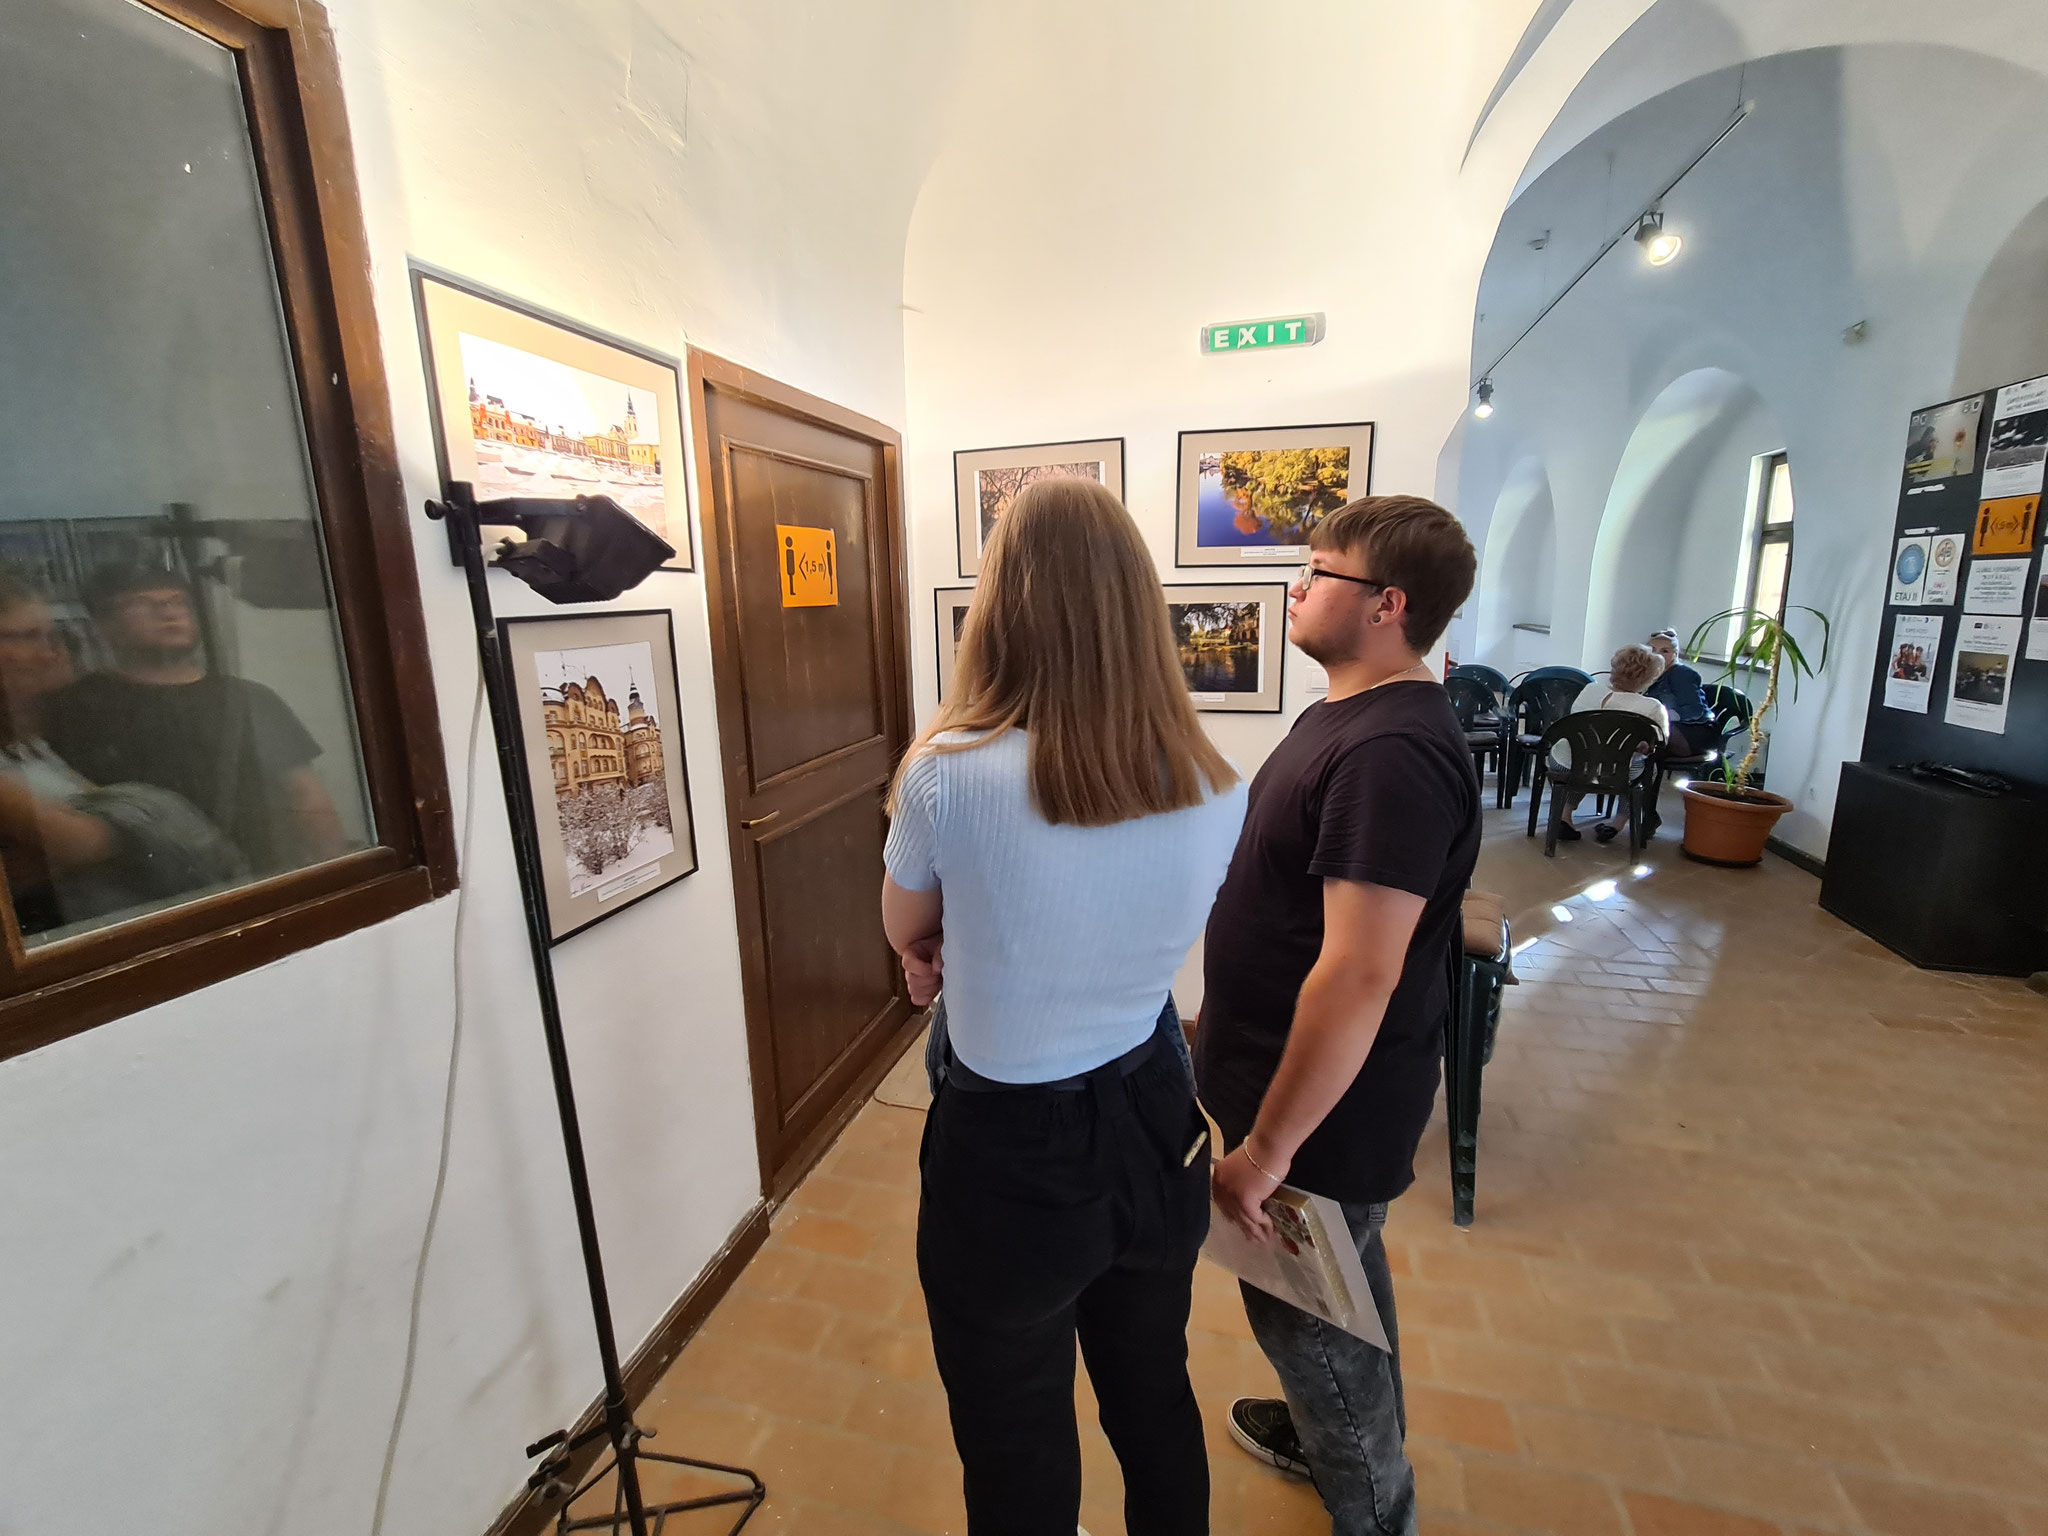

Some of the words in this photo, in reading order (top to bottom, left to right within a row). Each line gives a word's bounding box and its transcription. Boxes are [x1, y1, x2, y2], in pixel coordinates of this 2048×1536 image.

[1214, 321, 1302, 348] EXIT
[805, 560, 817, 575] 1,5
[818, 562, 824, 573] m
[1895, 591, 1911, 602] ETAJ
